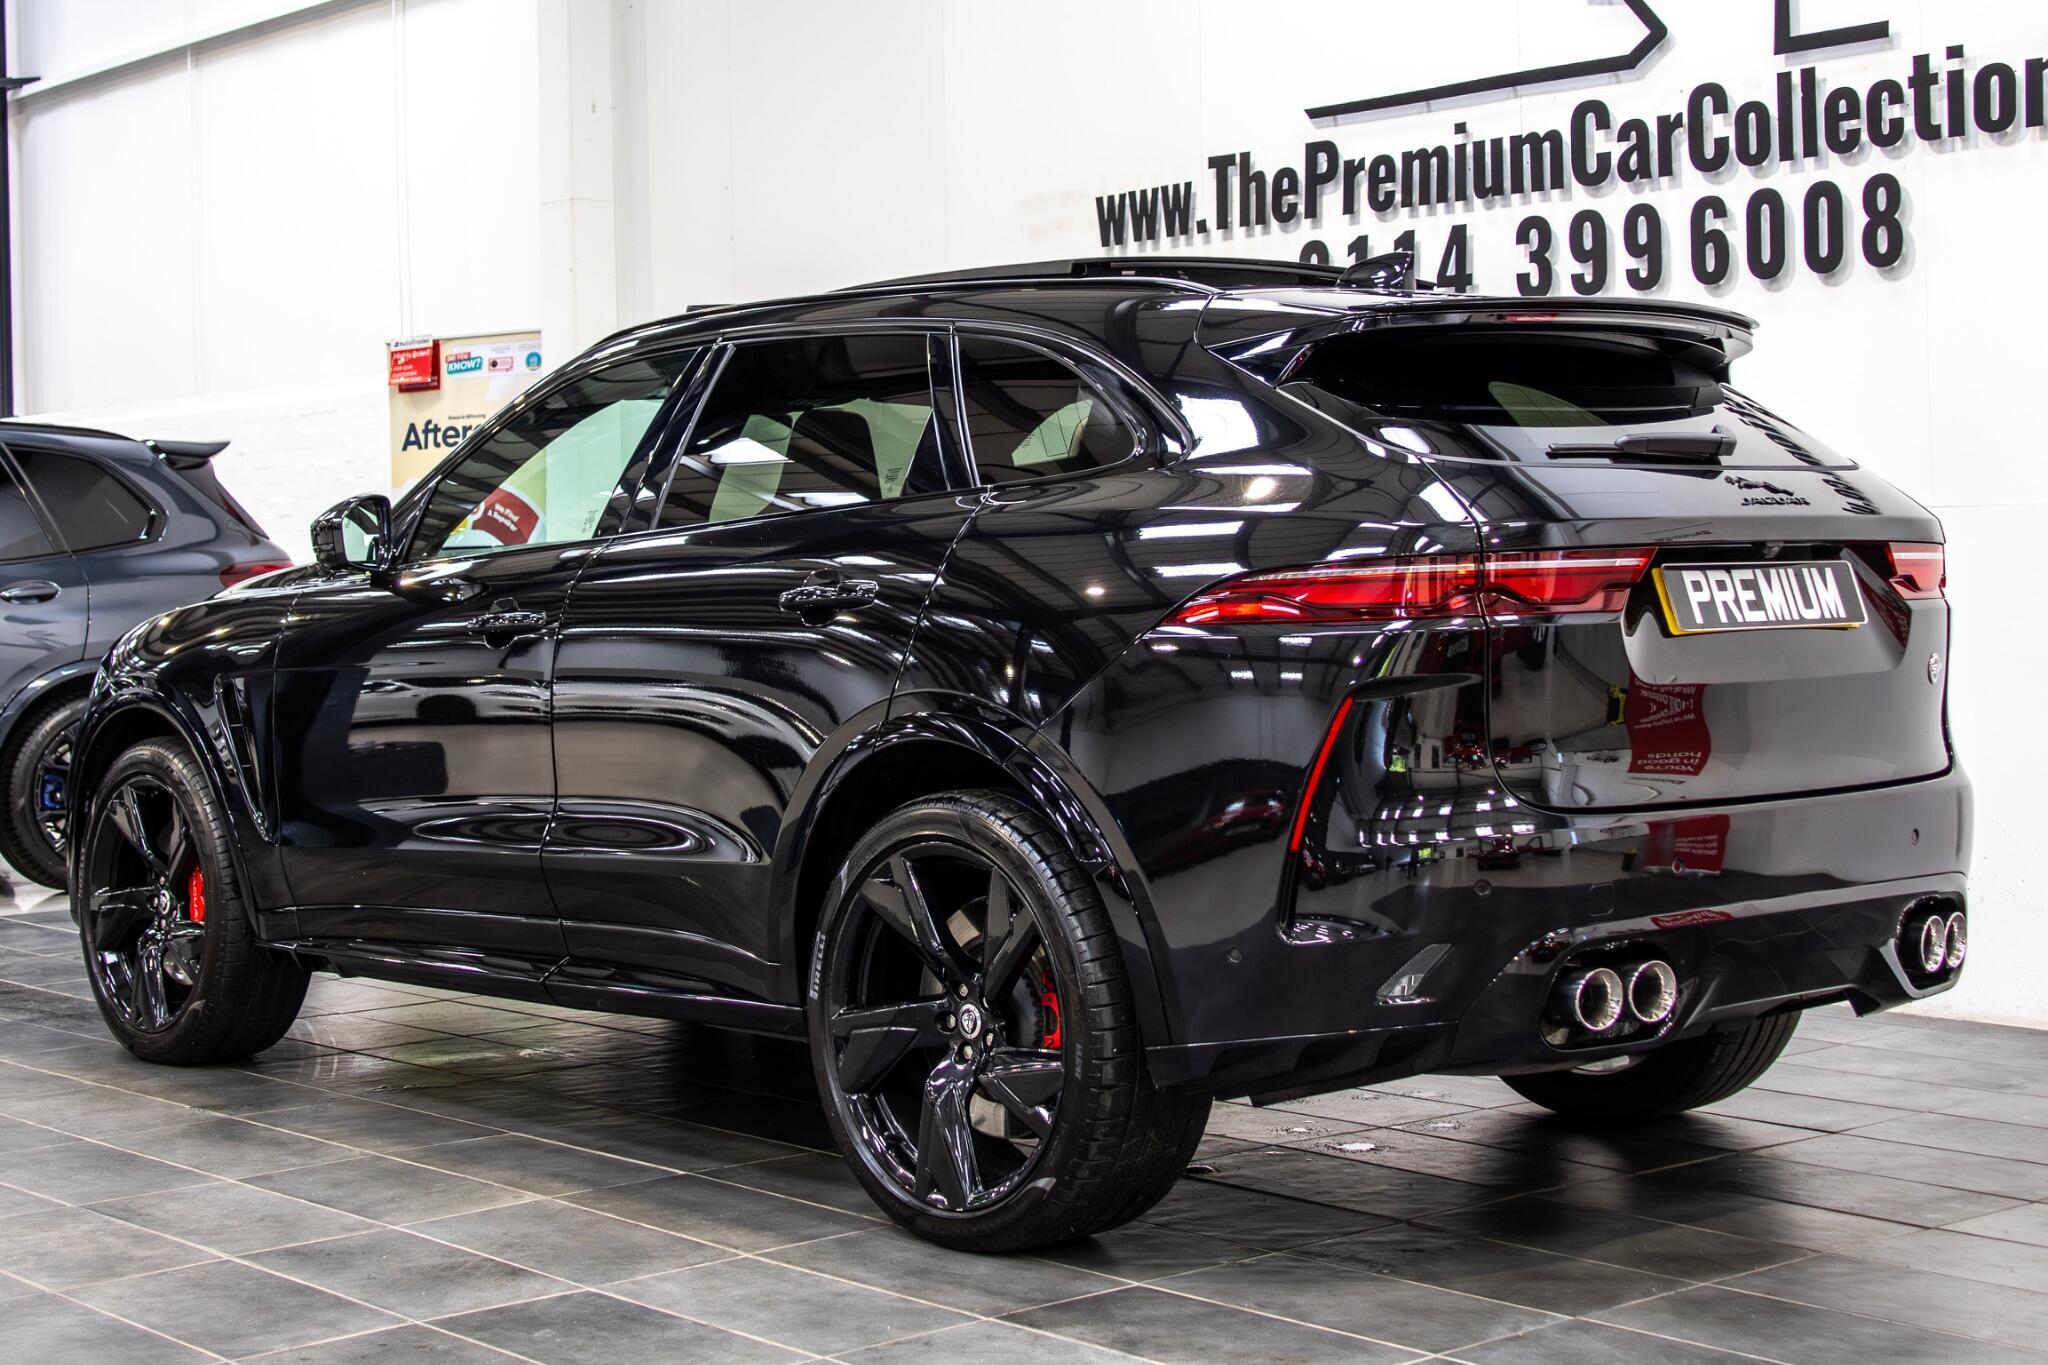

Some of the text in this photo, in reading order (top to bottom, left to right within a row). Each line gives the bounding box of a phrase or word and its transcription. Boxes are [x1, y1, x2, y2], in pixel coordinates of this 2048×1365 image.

[1516, 203, 1662, 297] 399
[1690, 173, 1904, 285] 6008
[448, 358, 481, 371] KNOW?
[1741, 497, 1811, 506] JAGUAR
[1681, 567, 1847, 624] PREMIUM
[809, 931, 826, 1000] PIRELLI
